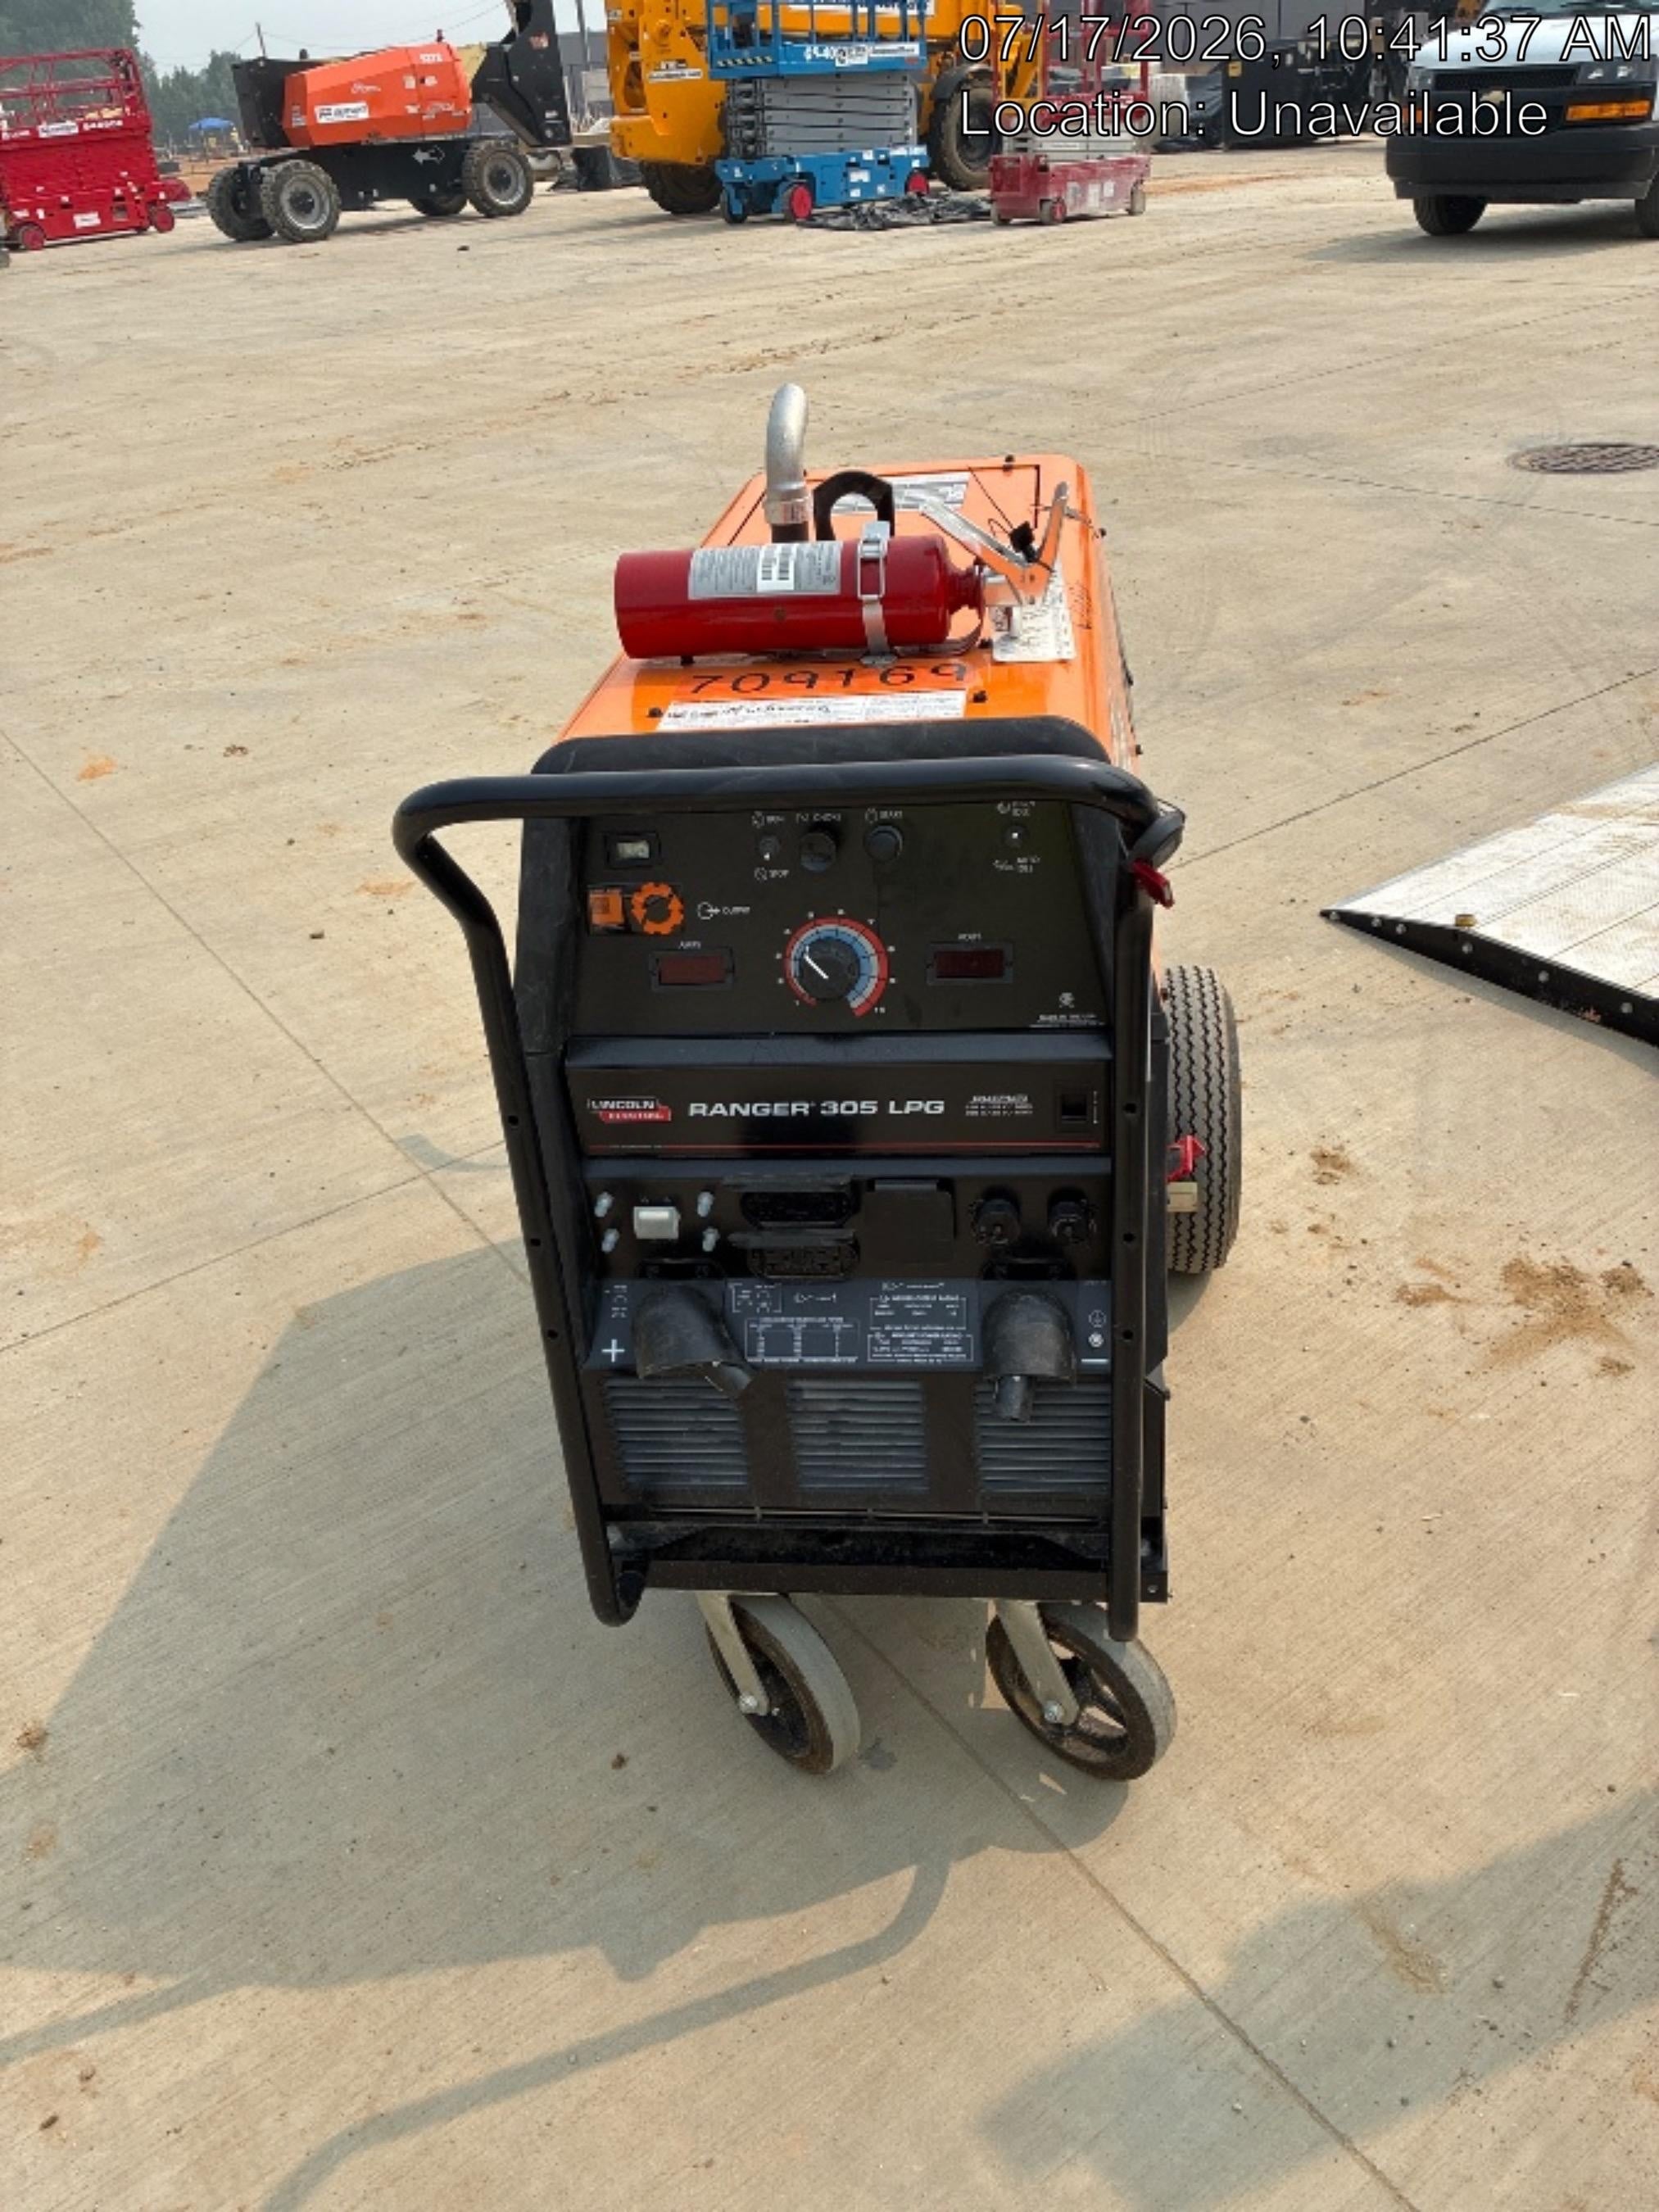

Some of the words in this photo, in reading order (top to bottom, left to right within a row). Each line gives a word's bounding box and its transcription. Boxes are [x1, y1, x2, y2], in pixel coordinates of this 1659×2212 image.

[691, 661, 967, 694] 709169
[591, 1100, 655, 1109] LINCOLN
[688, 1102, 810, 1117] RANGER
[820, 1100, 879, 1115] 305
[888, 1100, 945, 1114] LPG
